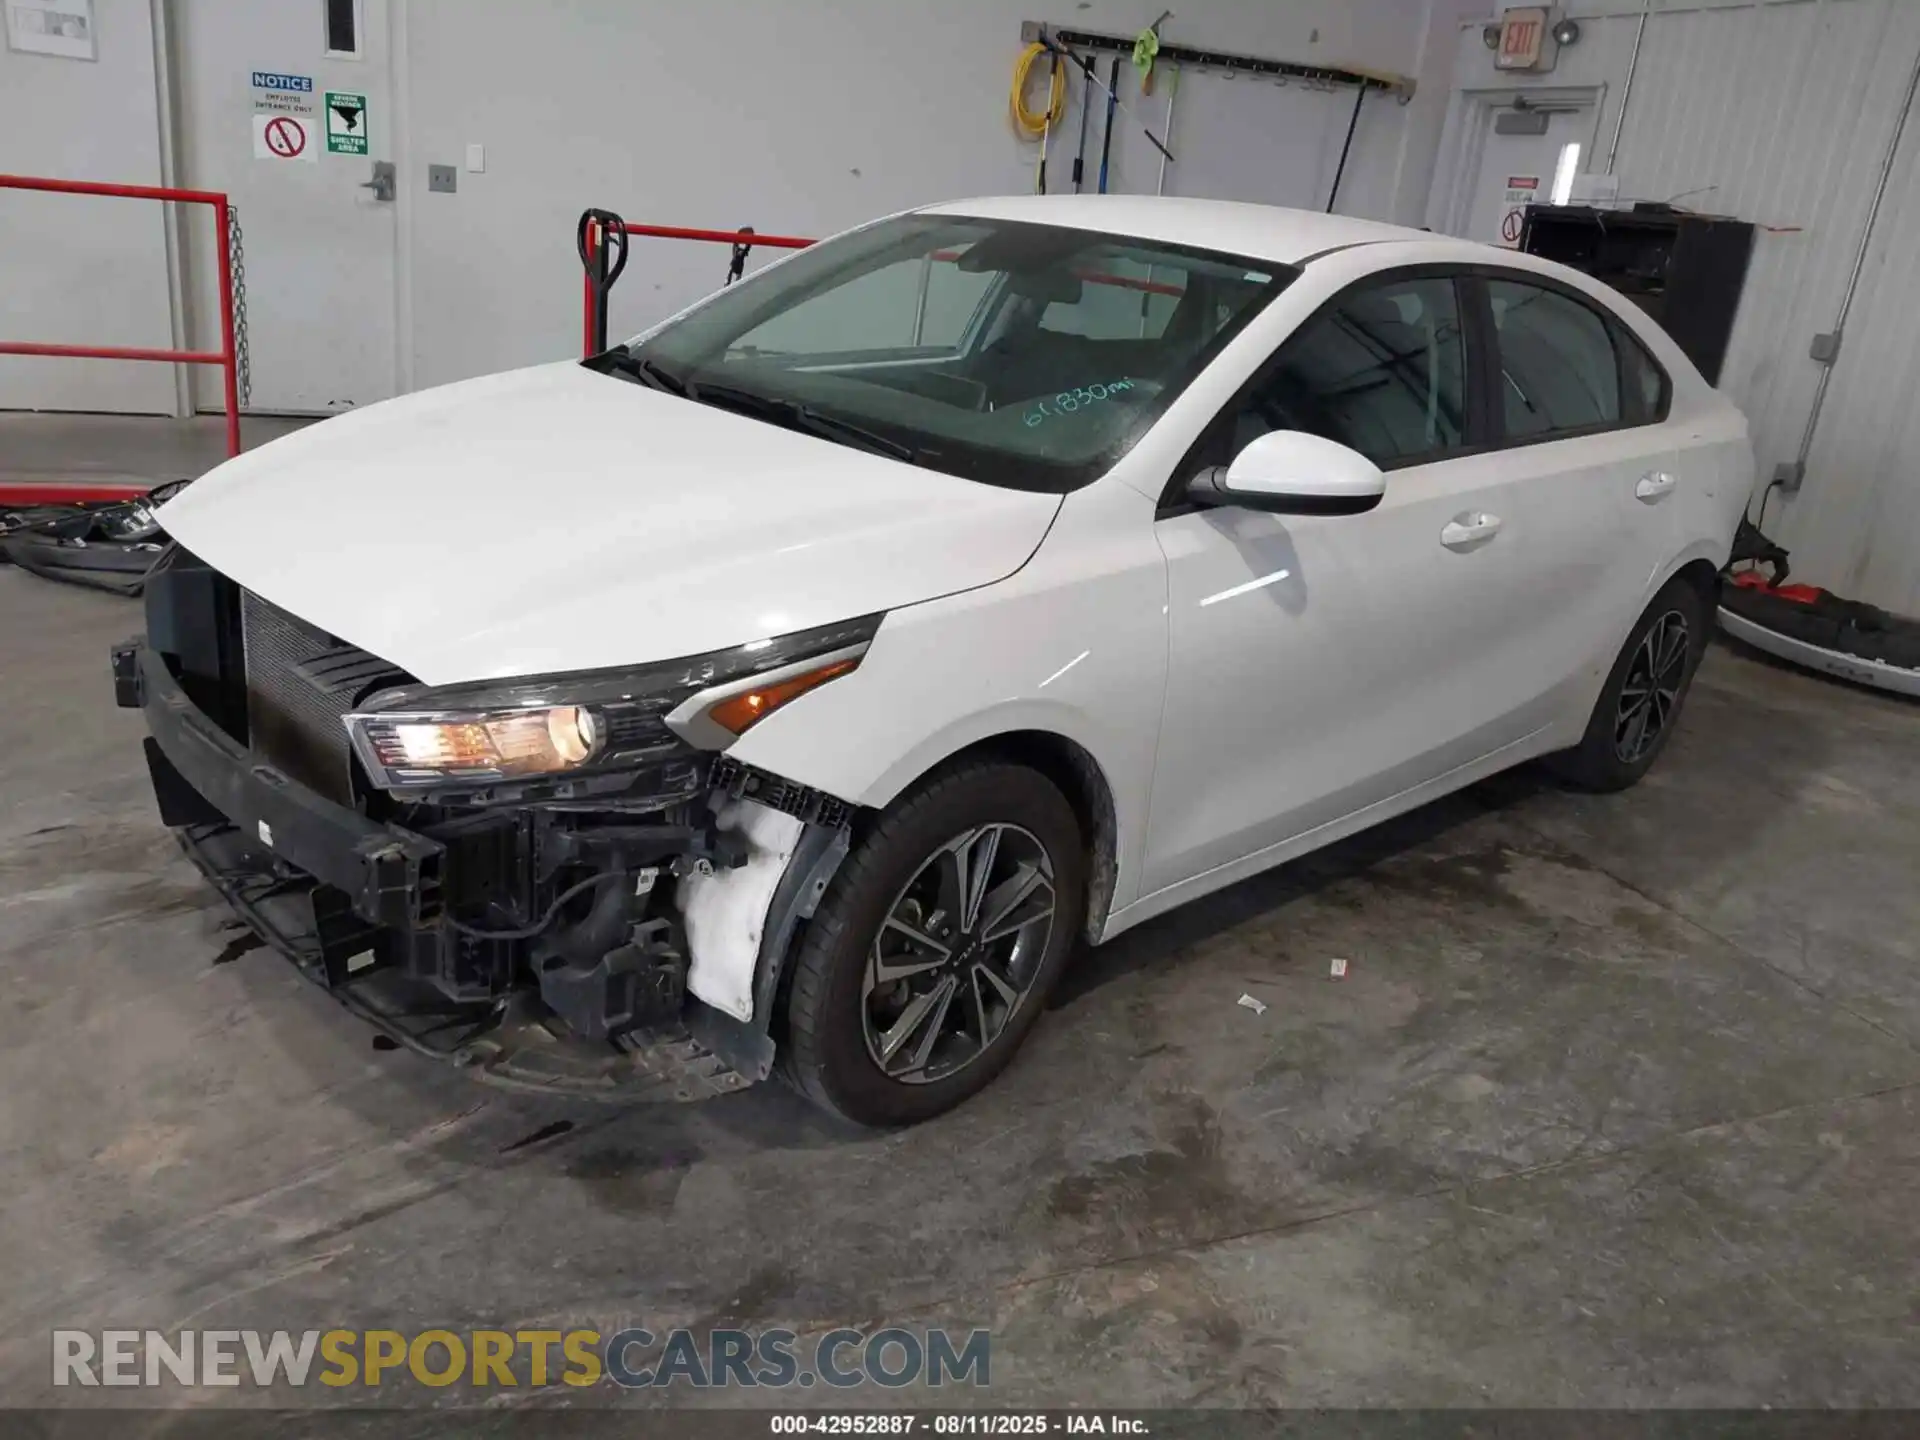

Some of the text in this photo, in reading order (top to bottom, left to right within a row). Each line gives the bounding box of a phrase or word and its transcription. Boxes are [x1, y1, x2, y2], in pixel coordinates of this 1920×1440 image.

[254, 74, 310, 90] NOTICE
[294, 104, 312, 113] ONLY
[330, 136, 365, 146] SHELTER
[338, 144, 359, 153] AREA
